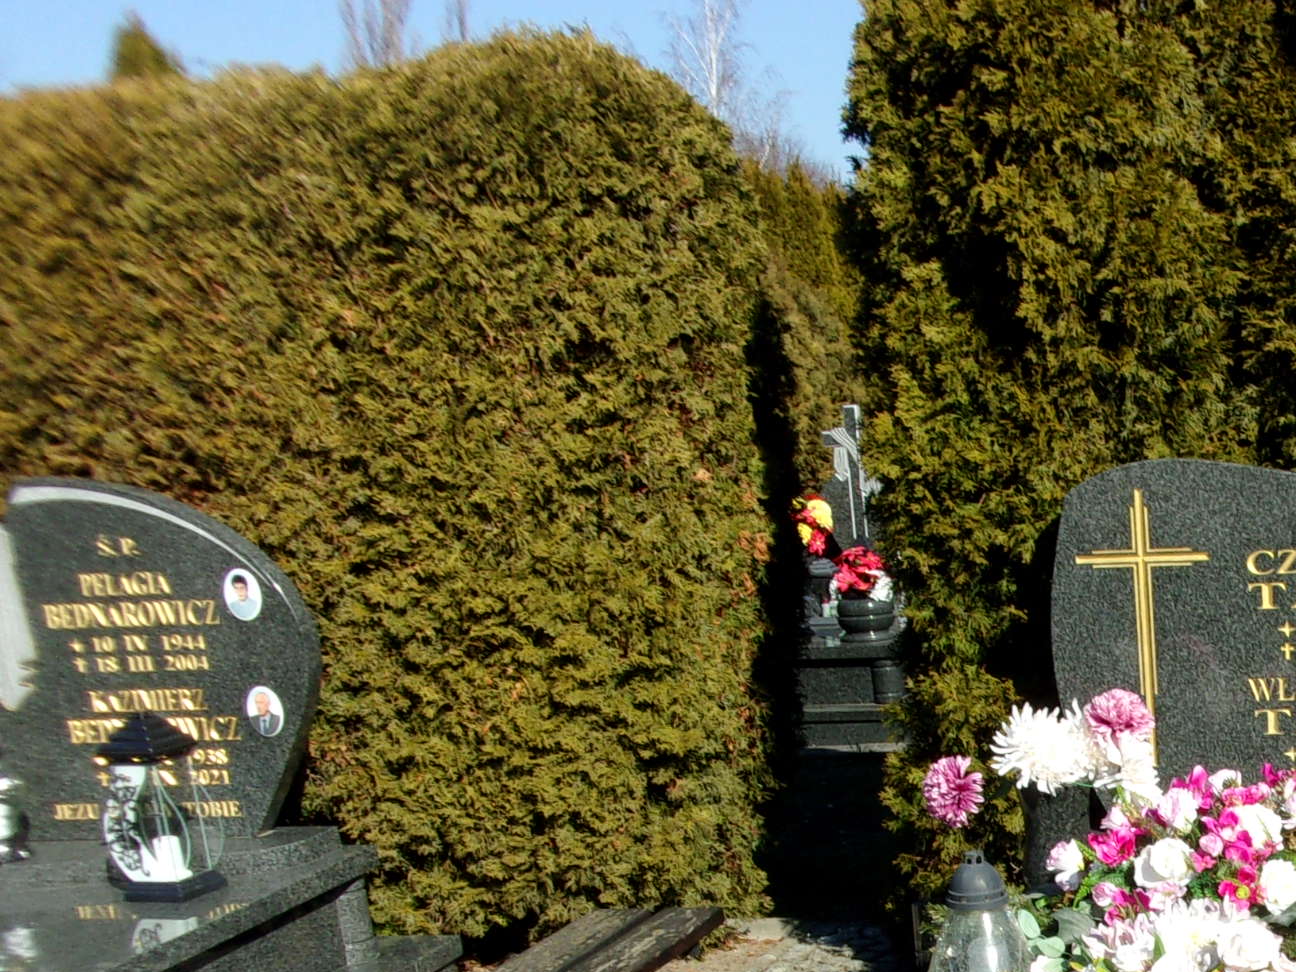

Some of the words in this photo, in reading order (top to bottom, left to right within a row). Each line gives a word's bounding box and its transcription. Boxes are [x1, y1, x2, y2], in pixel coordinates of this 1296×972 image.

[77, 571, 174, 597] PELAGIA
[42, 599, 221, 630] BEDNAROWICZ
[123, 634, 149, 651] IV
[160, 633, 206, 651] 1944
[163, 653, 210, 671] 2004
[87, 688, 208, 713] KAZIMIERZ
[190, 748, 230, 766] 938
[53, 803, 99, 820] JEZU
